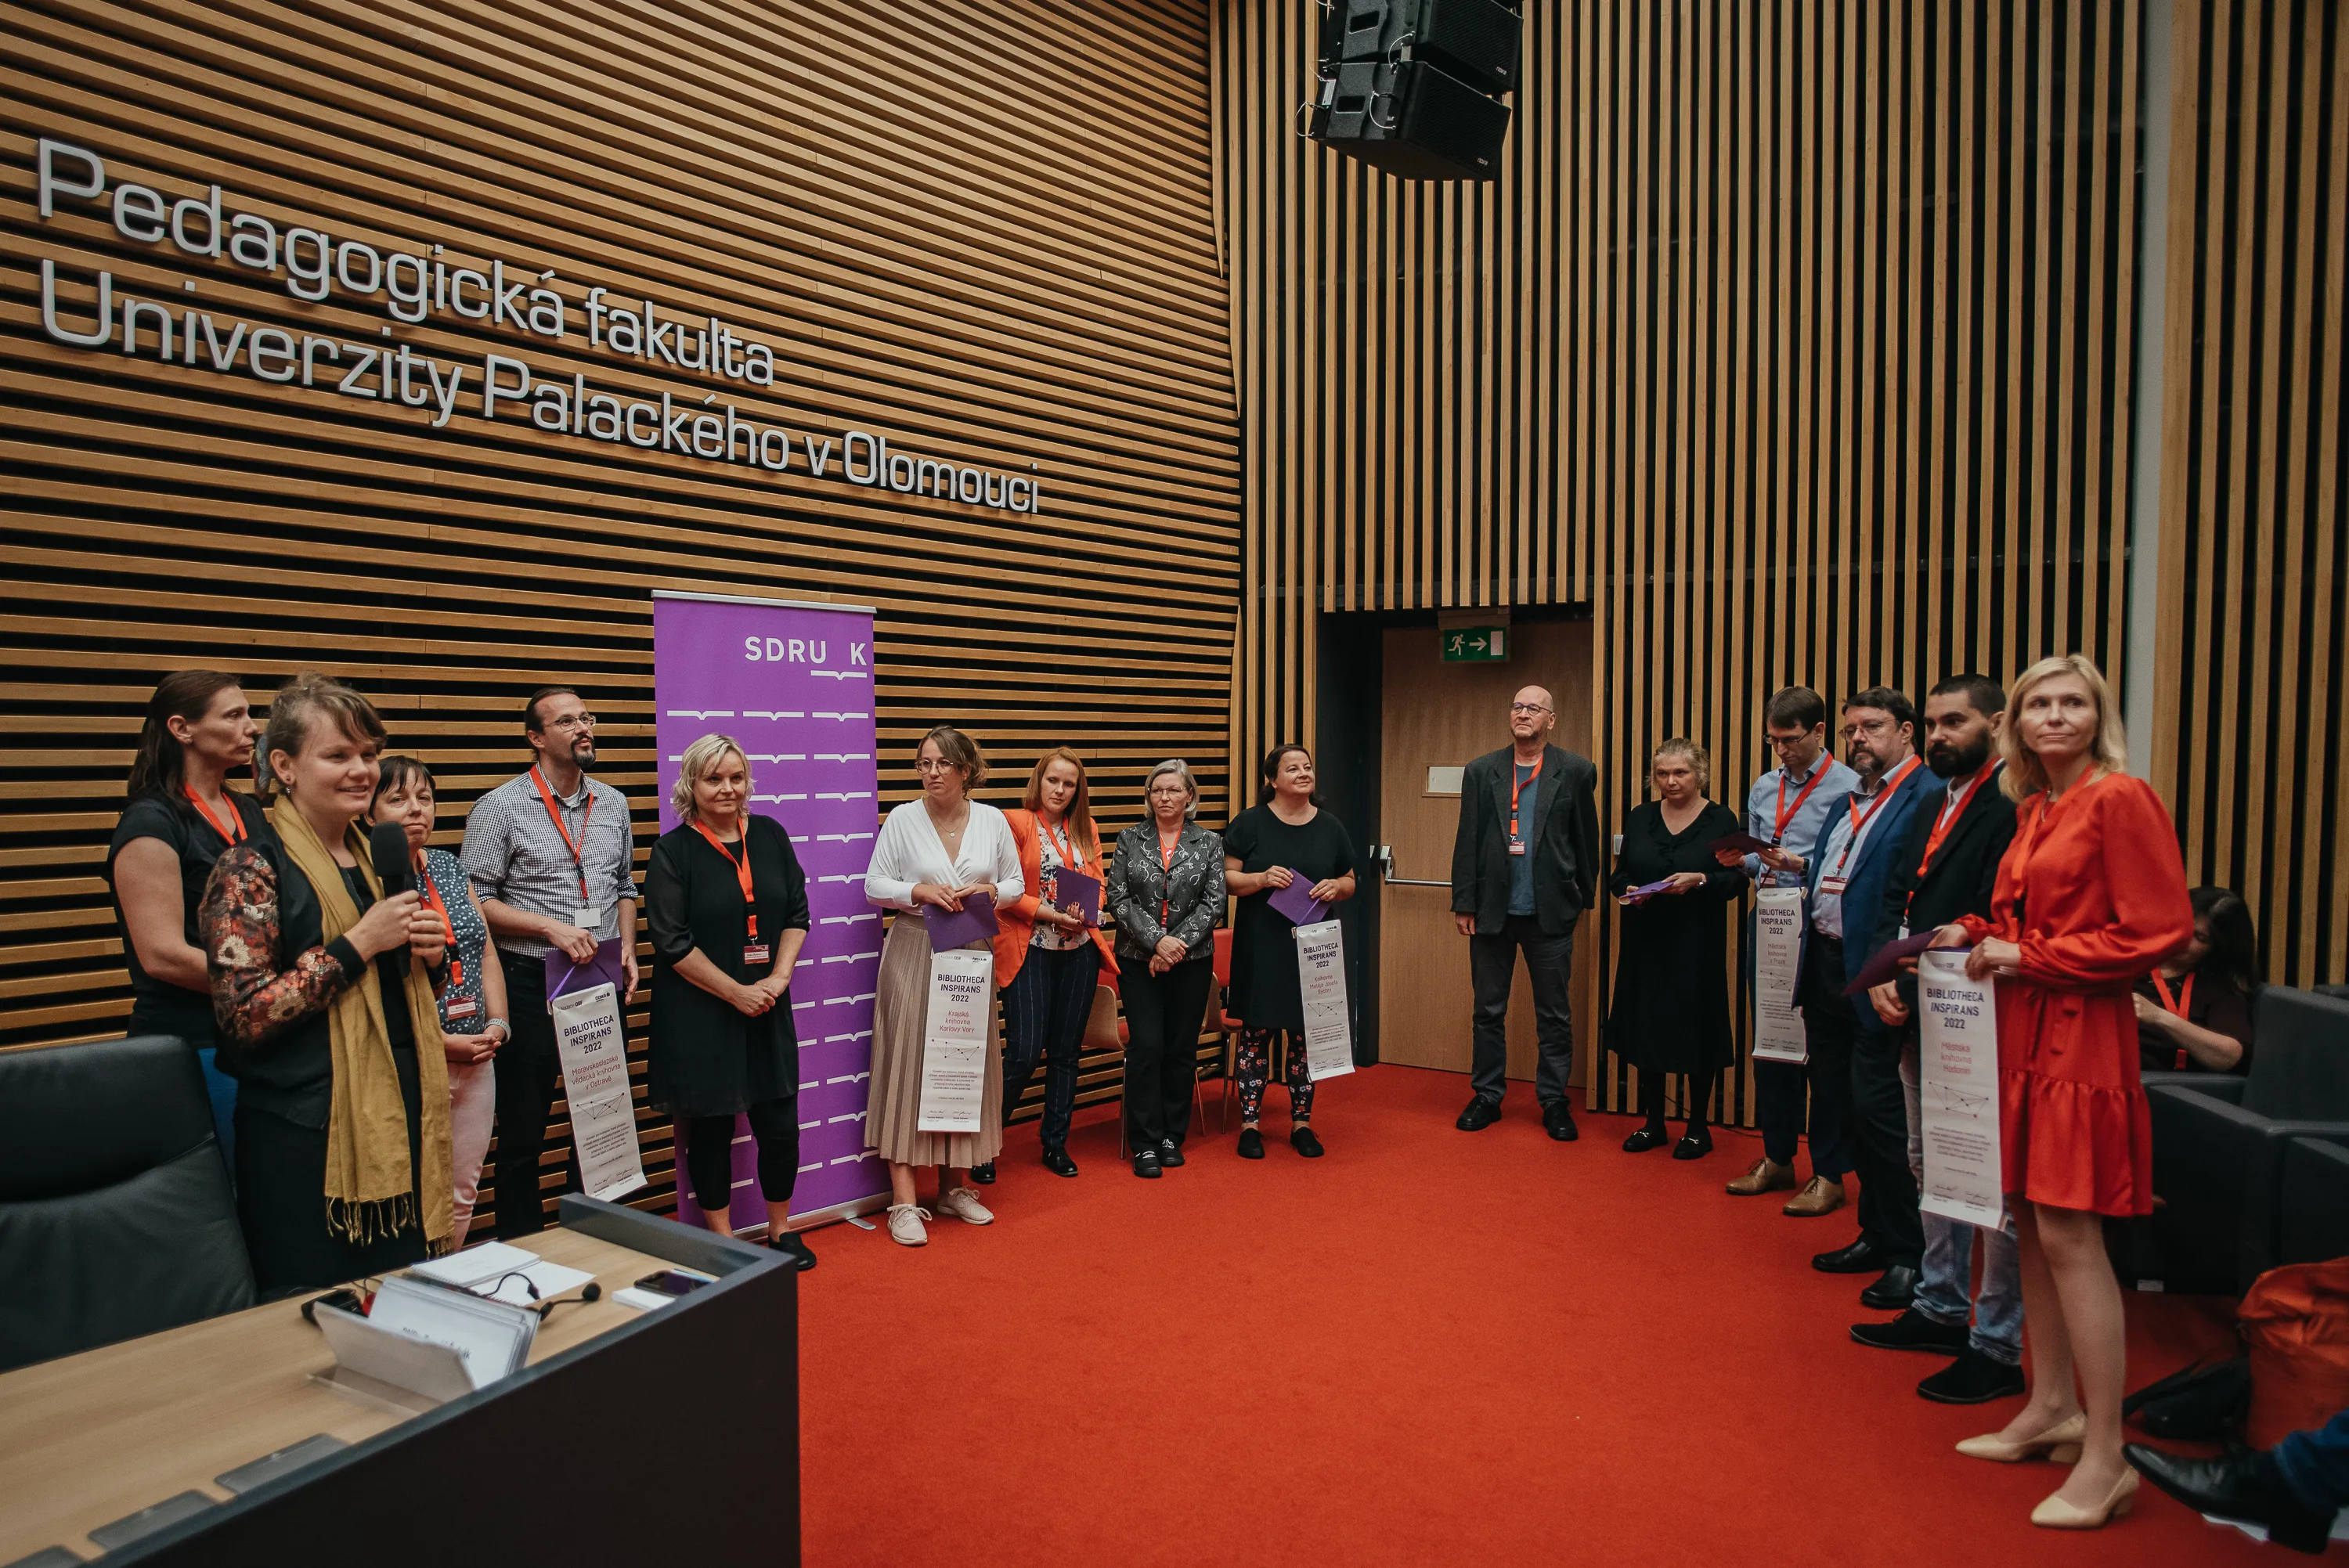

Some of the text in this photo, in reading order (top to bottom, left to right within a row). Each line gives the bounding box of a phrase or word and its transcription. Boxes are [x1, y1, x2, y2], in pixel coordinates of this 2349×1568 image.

[38, 137, 774, 387] Pedagogická fakulta
[41, 258, 1038, 514] Univerzity Palackého v Olomouci
[1303, 943, 1339, 954] BIBLIOTHECA
[1307, 951, 1337, 961] INSPIRANS
[937, 974, 985, 983] BIBLIOTHECA
[940, 984, 980, 993] INSPIRANS
[1926, 987, 1985, 1003] BIBLIOTHECA
[1930, 1002, 1980, 1016] INSPIRANS
[564, 1015, 615, 1037] BIBLIOTHECA
[1943, 1017, 1965, 1029] 2022
[570, 1026, 612, 1047] INSPIRANS
[583, 1040, 602, 1054] 2022
[572, 1055, 619, 1076] Moravskoslezská
[572, 1063, 621, 1085] vědecká knihovna
[590, 1076, 612, 1088] Ostravě
